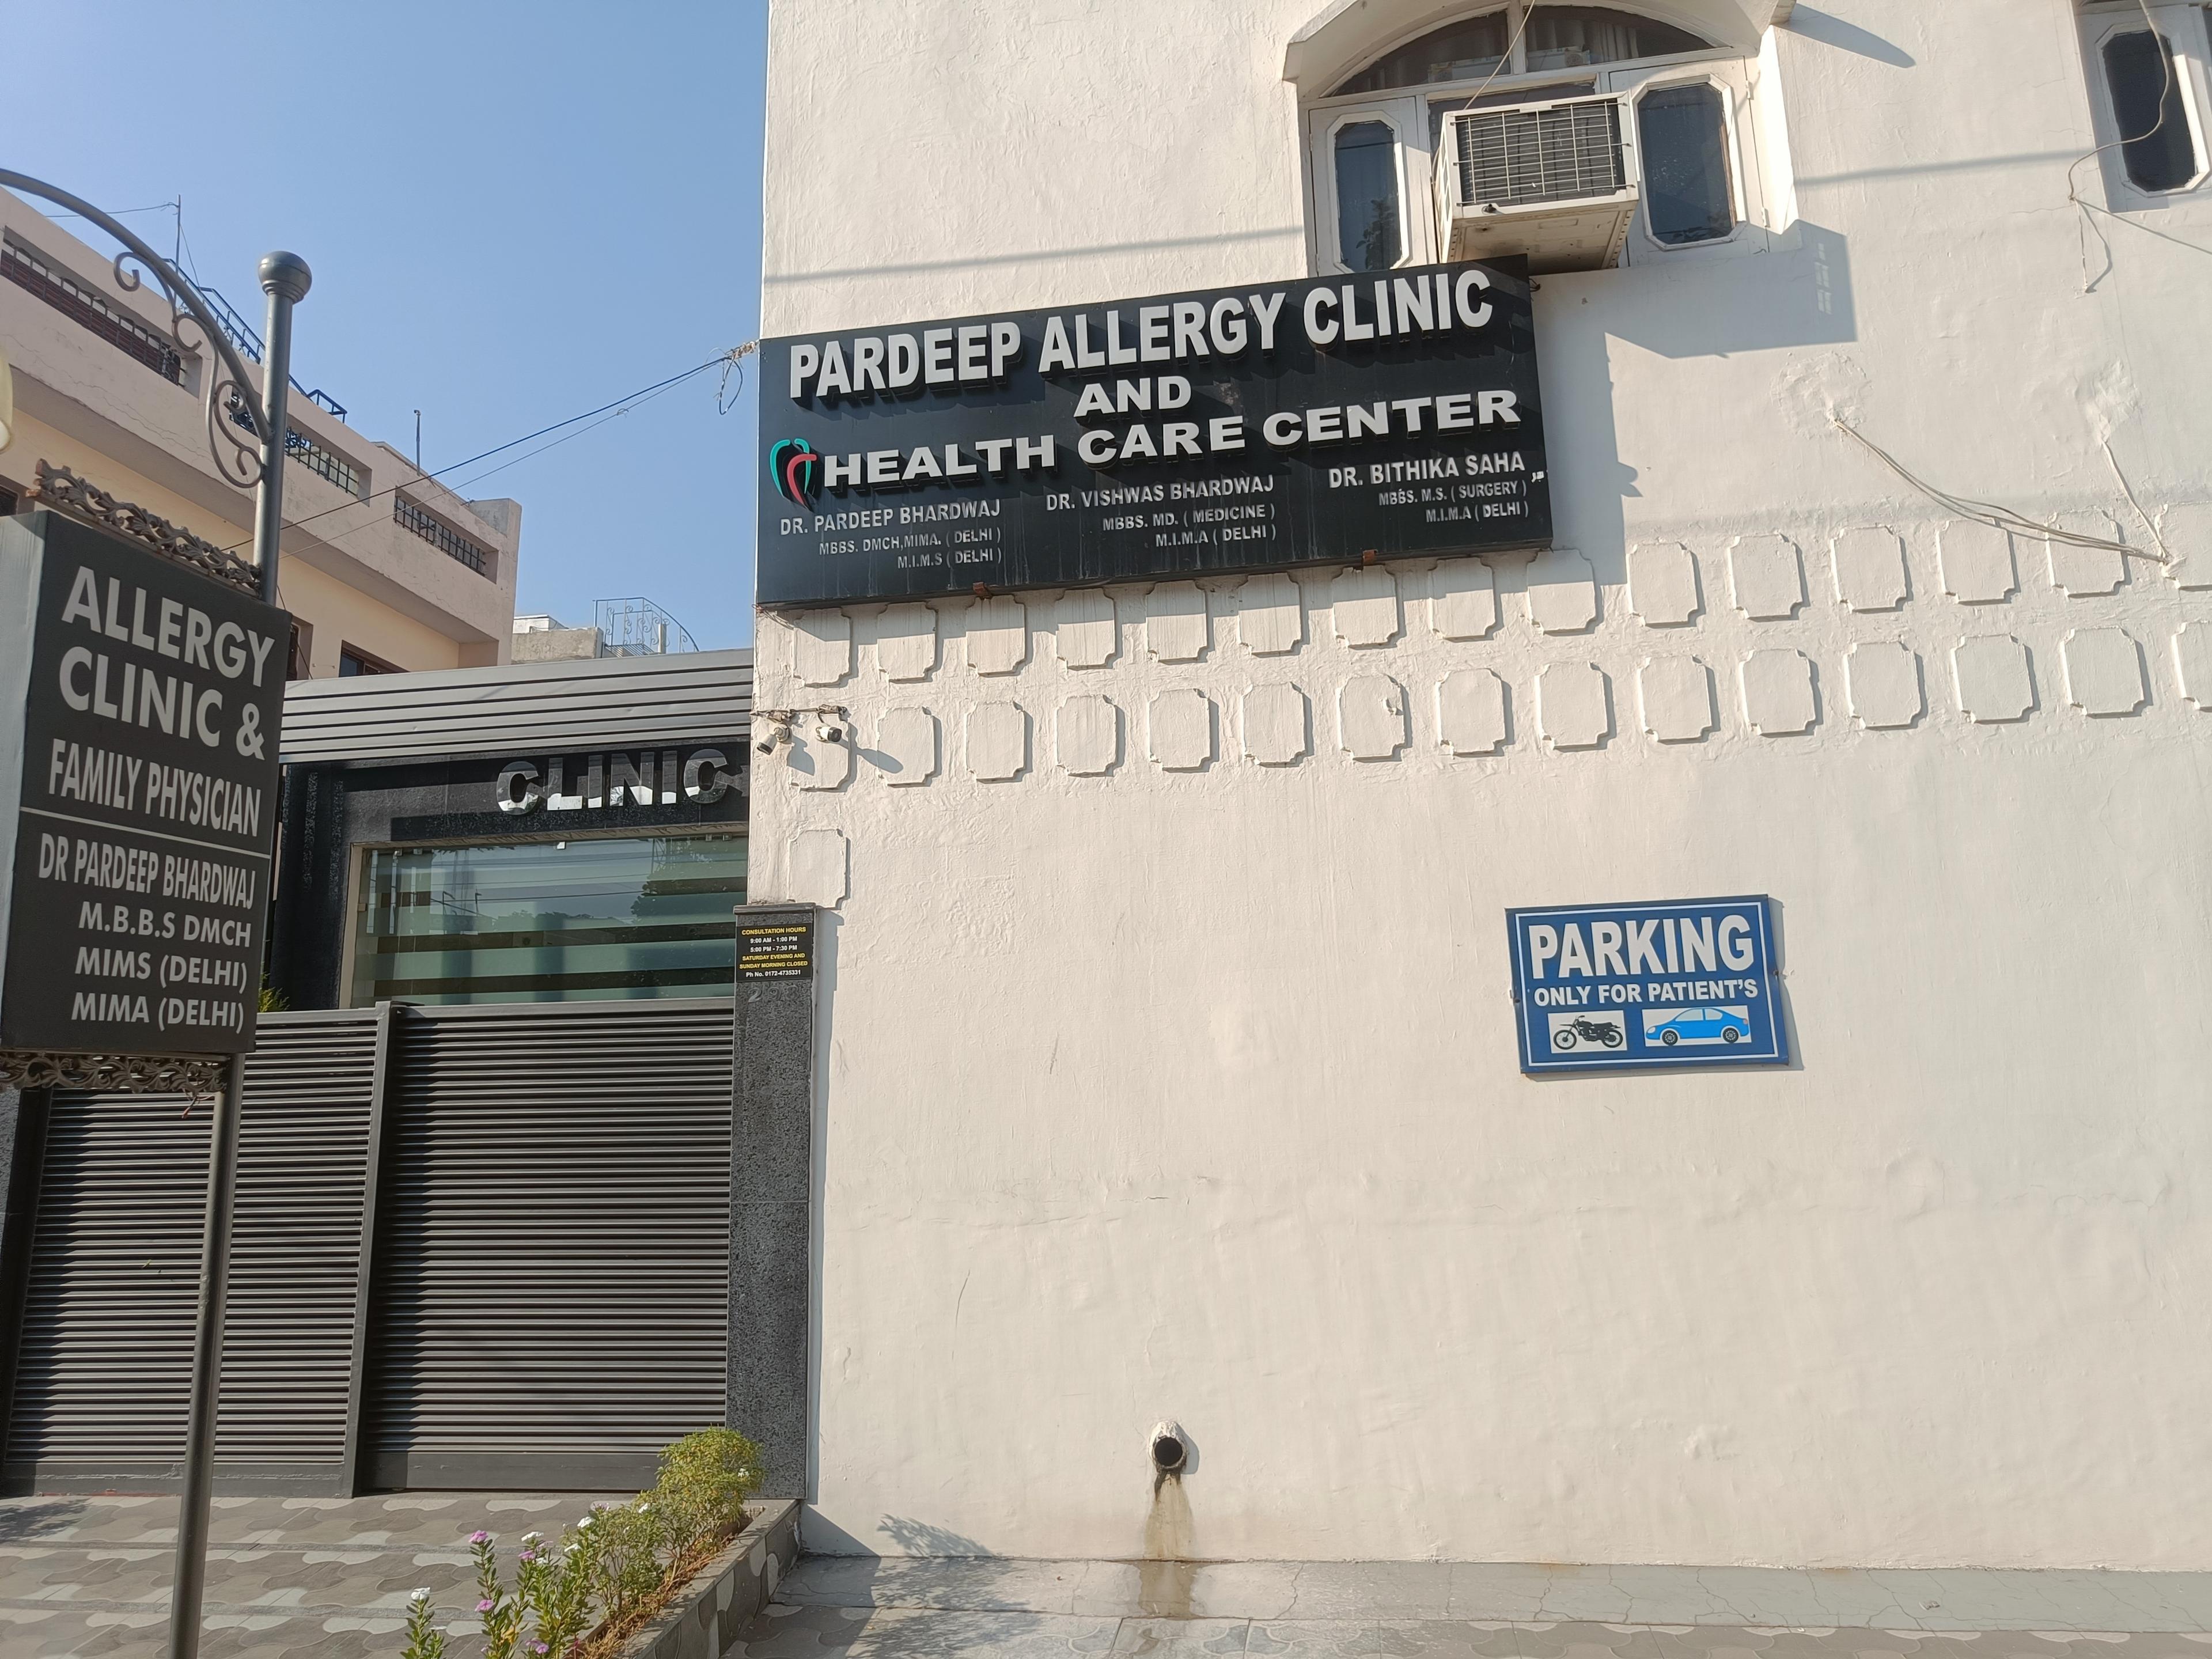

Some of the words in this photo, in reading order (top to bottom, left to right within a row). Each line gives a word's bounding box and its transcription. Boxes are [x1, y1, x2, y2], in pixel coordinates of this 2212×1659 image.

[790, 322, 1021, 399] PARDEEP
[1038, 292, 1286, 373] ALLERGY
[1304, 270, 1493, 344] CLINIC
[1074, 376, 1191, 418] AND
[824, 434, 1055, 487] HEALTH
[1078, 415, 1245, 463] CARE
[1263, 390, 1521, 446] CENTER
[1328, 467, 1363, 488] DR.
[1370, 457, 1459, 484] BITHIKA
[1465, 452, 1525, 475] SAHA
[1046, 494, 1075, 511] DR.
[1081, 484, 1164, 507] VISHWAS
[1170, 475, 1274, 500] BHARDWAJ
[1379, 490, 1418, 506] MBBS.
[1422, 487, 1447, 501] M.S.
[781, 518, 808, 535] DR.
[815, 509, 893, 532] PARDEEP
[900, 499, 1000, 524] BHARDWAJ
[1103, 516, 1148, 531] MBBS.
[1153, 513, 1179, 527] MD.
[1426, 508, 1471, 522] M.I.M.A
[819, 541, 858, 555] MBBS.
[1156, 531, 1208, 547] M.I.M.A
[897, 553, 942, 569] M.I.M.S
[62, 565, 275, 688] ALLERGY
[59, 646, 223, 748] CLINIC
[236, 704, 266, 760] &
[48, 738, 142, 812] FAMILY
[146, 762, 261, 837] PHYSICIAN
[496, 749, 728, 815] CLINIC
[39, 833, 69, 881] DR
[74, 838, 159, 895] PARDEEP
[162, 857, 255, 910] BHARDWAJ
[78, 902, 176, 940] M.B.B.S
[184, 914, 252, 948] DMCH
[1529, 914, 1753, 979] PARKING
[74, 948, 151, 980] MIMS
[160, 955, 248, 994] (DELHI)
[1534, 986, 1591, 1006] ONLY
[1598, 983, 1642, 1003] FOR
[1649, 979, 1758, 1002] PATIENT'S
[71, 993, 150, 1024] MIMA
[158, 997, 244, 1034] (DELHI)
